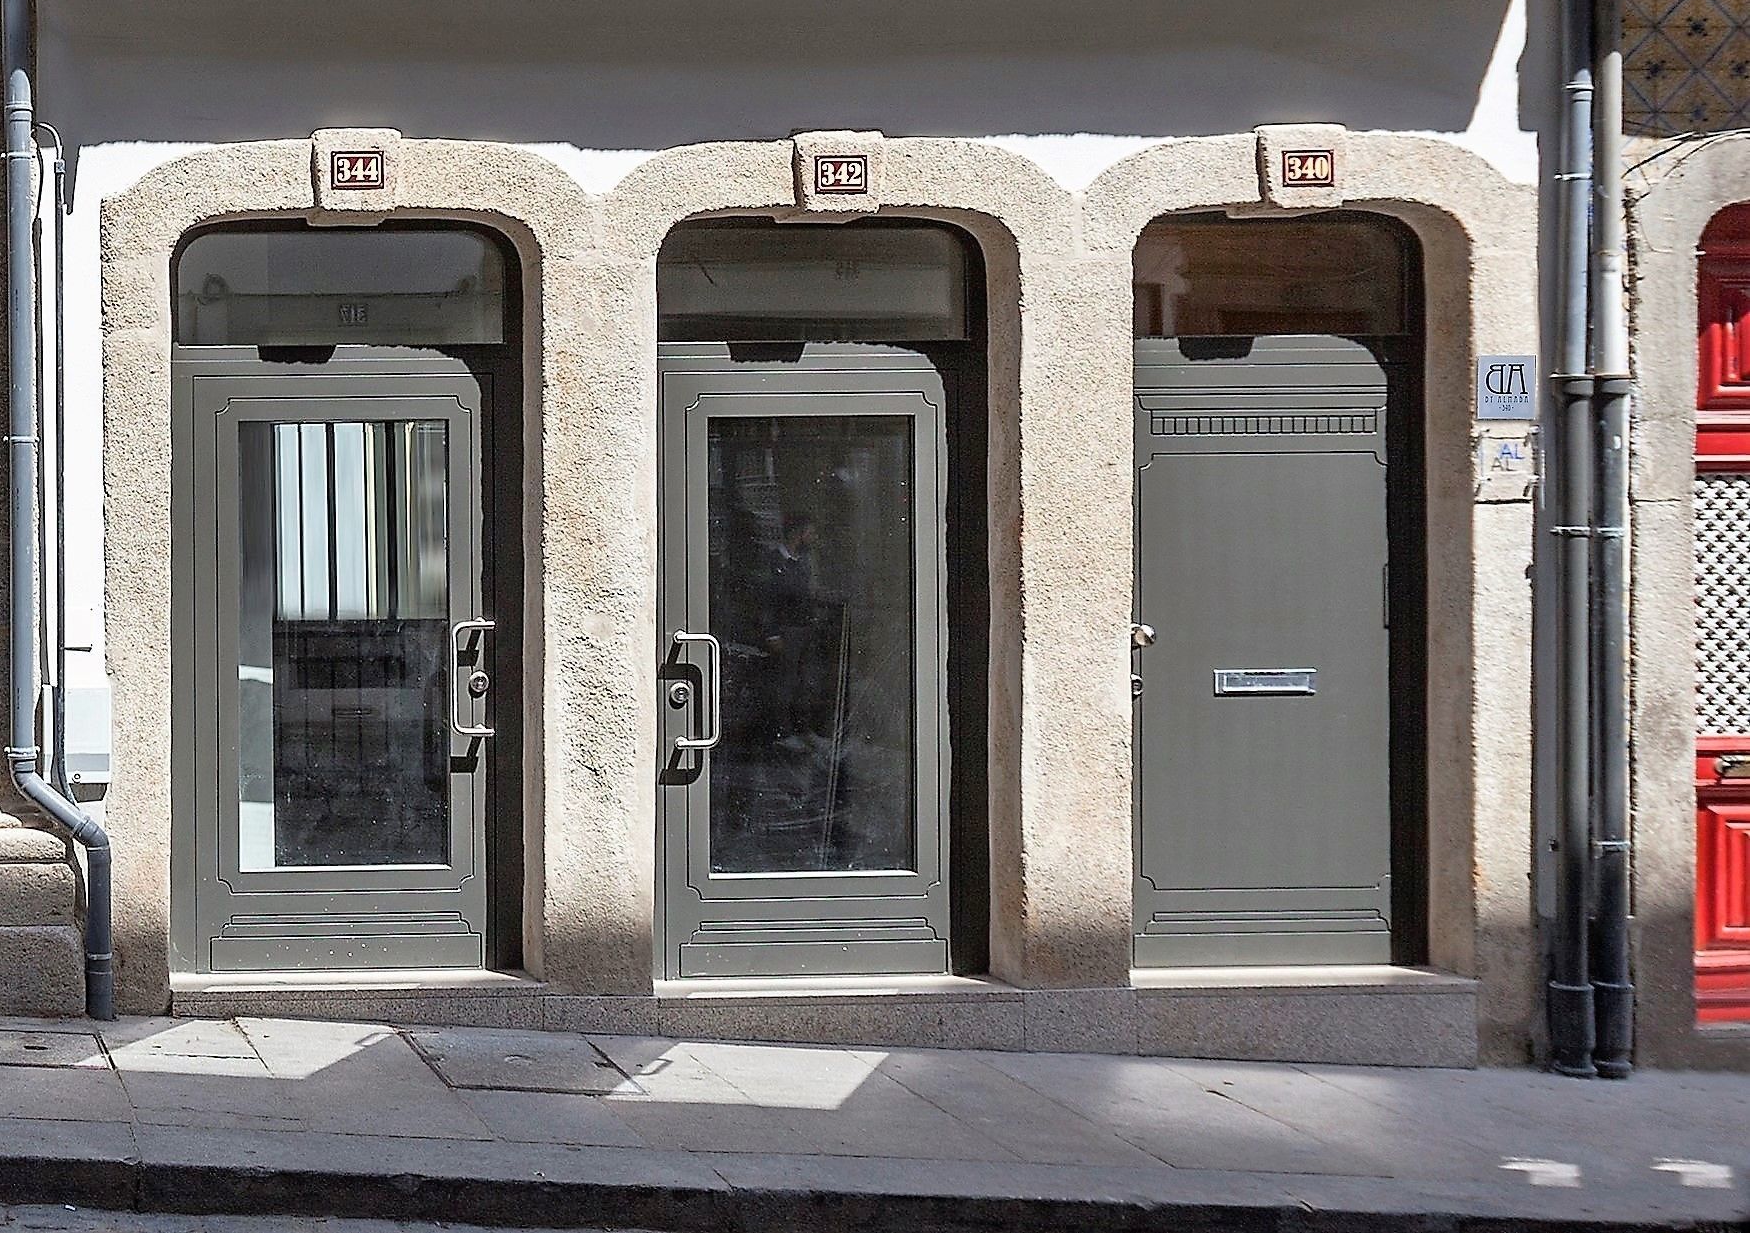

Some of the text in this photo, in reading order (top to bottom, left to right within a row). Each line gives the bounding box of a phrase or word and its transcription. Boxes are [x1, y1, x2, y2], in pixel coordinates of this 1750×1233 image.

[337, 157, 379, 182] 344
[821, 162, 862, 186] 342
[1287, 156, 1329, 180] 340
[1500, 443, 1526, 460] AL
